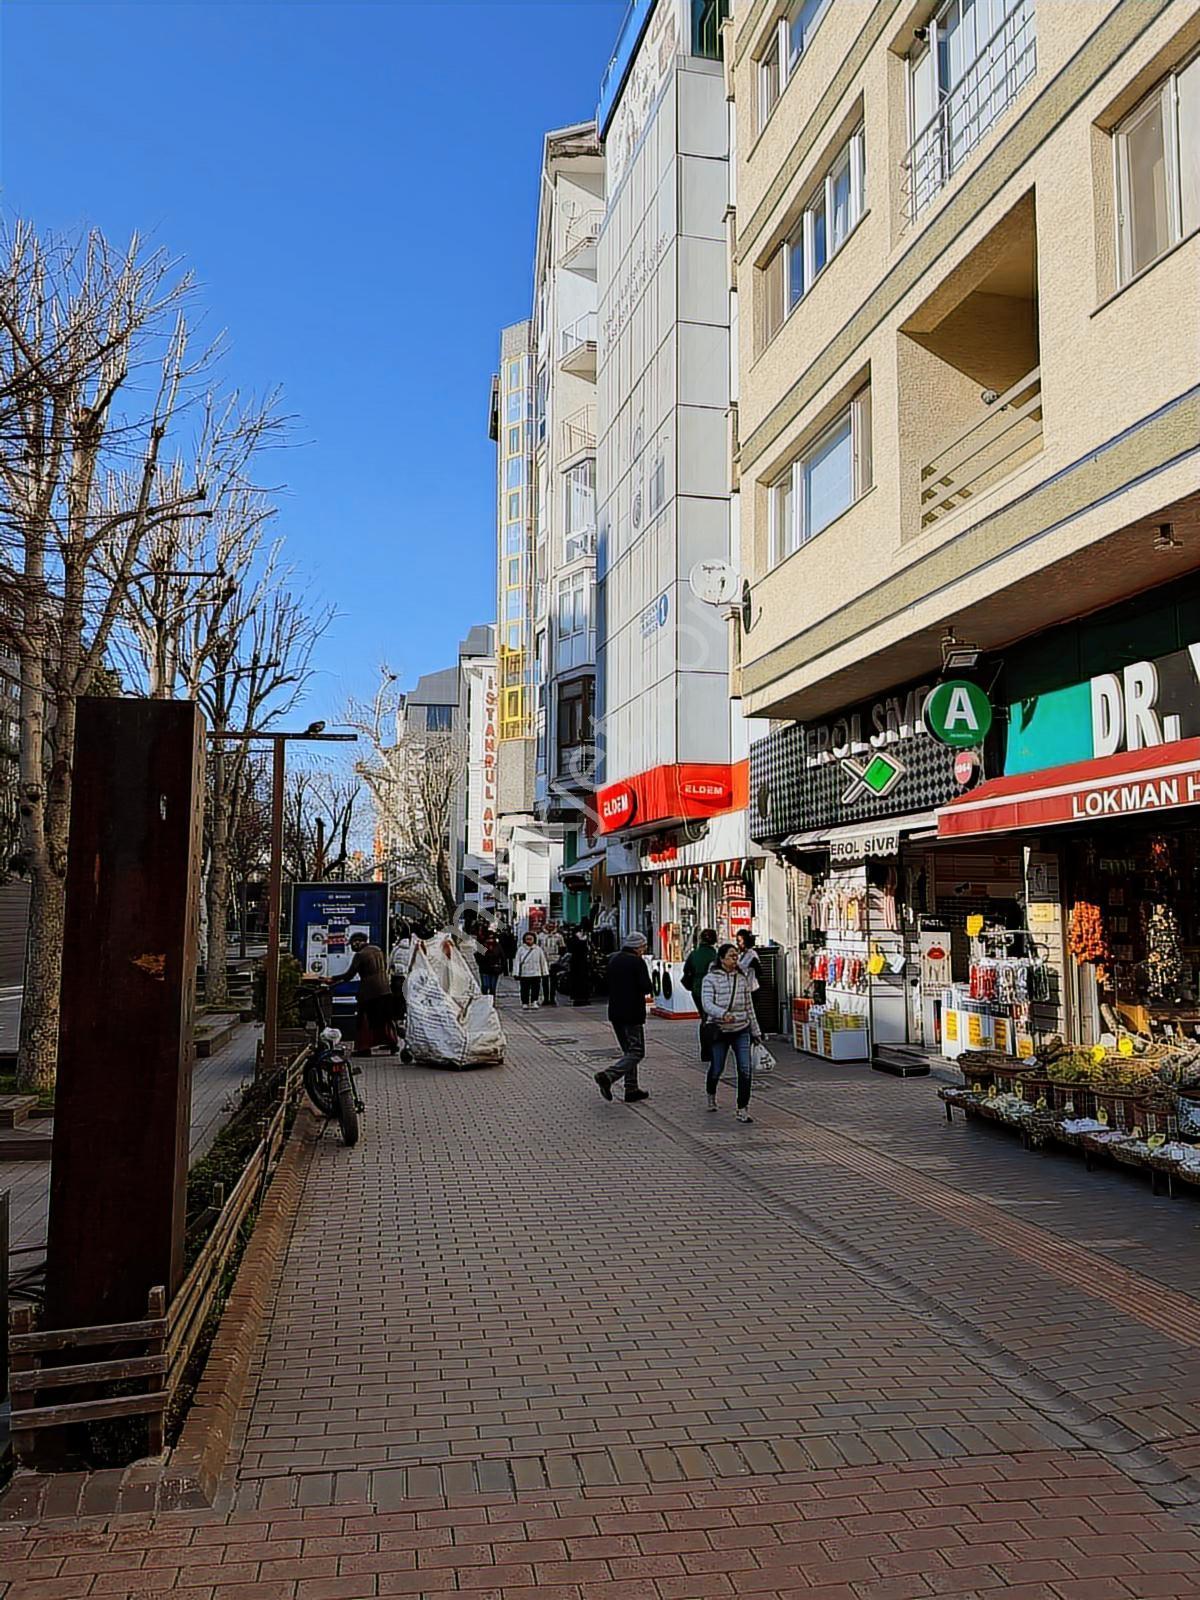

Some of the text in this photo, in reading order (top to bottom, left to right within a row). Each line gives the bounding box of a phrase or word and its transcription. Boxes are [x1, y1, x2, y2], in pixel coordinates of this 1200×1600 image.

[807, 685, 931, 769] EROL SİVR
[943, 687, 979, 730] A
[1091, 661, 1181, 759] DR.
[603, 794, 629, 817] ELDEM
[685, 785, 723, 795] ELDEM
[1073, 779, 1178, 818] LOKMAN
[831, 841, 860, 855] EROL
